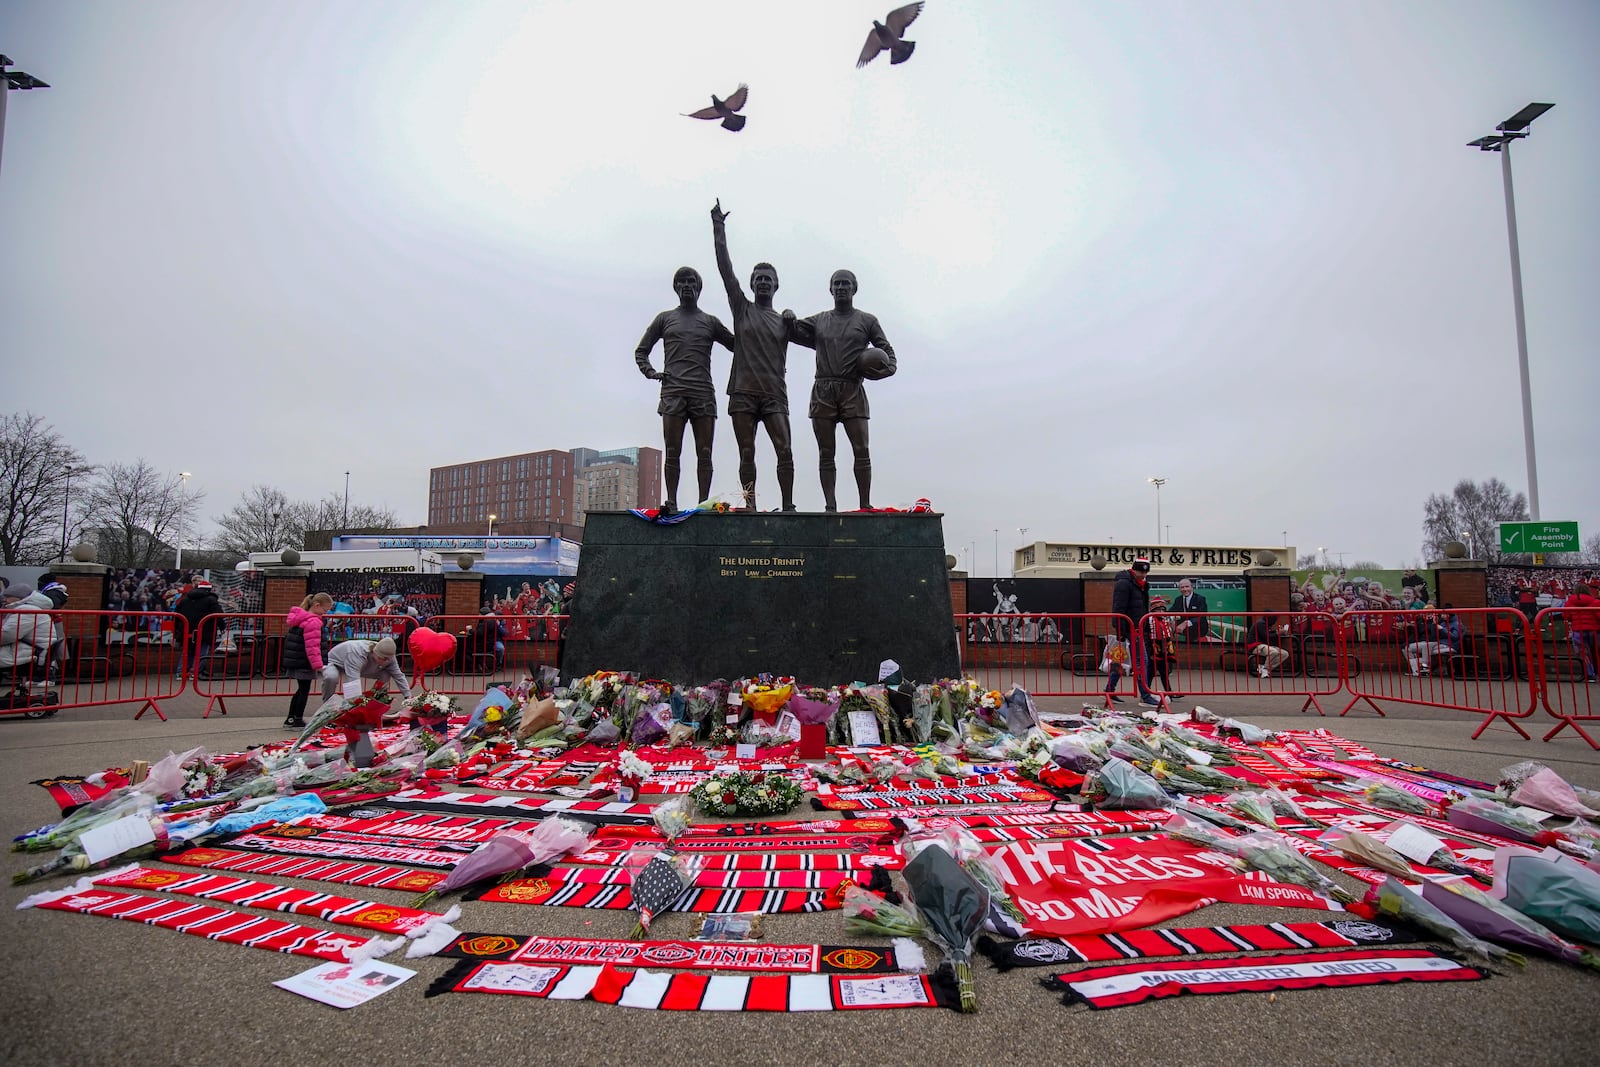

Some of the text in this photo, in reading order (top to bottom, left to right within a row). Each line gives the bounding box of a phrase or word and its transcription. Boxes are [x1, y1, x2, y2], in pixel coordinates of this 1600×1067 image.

[378, 538, 537, 549] TRADITIONAL FISH & CHIPS
[1530, 534, 1574, 542] Assembly
[719, 556, 806, 566] THE UNITED TRINITY
[1169, 549, 1185, 565] &
[1190, 550, 1252, 566] FRIES
[362, 565, 416, 573] CATERING
[720, 569, 803, 577] BEST LAW CHARLTON
[1003, 812, 1098, 824] UNITED
[377, 822, 475, 842] UNITED
[984, 841, 1066, 886] THE
[1073, 849, 1206, 885] REDS
[1018, 895, 1075, 922] GO
[527, 942, 642, 958] UNITED
[700, 948, 811, 964] UNITED
[1141, 960, 1397, 986] MANCHESTER UNITED
